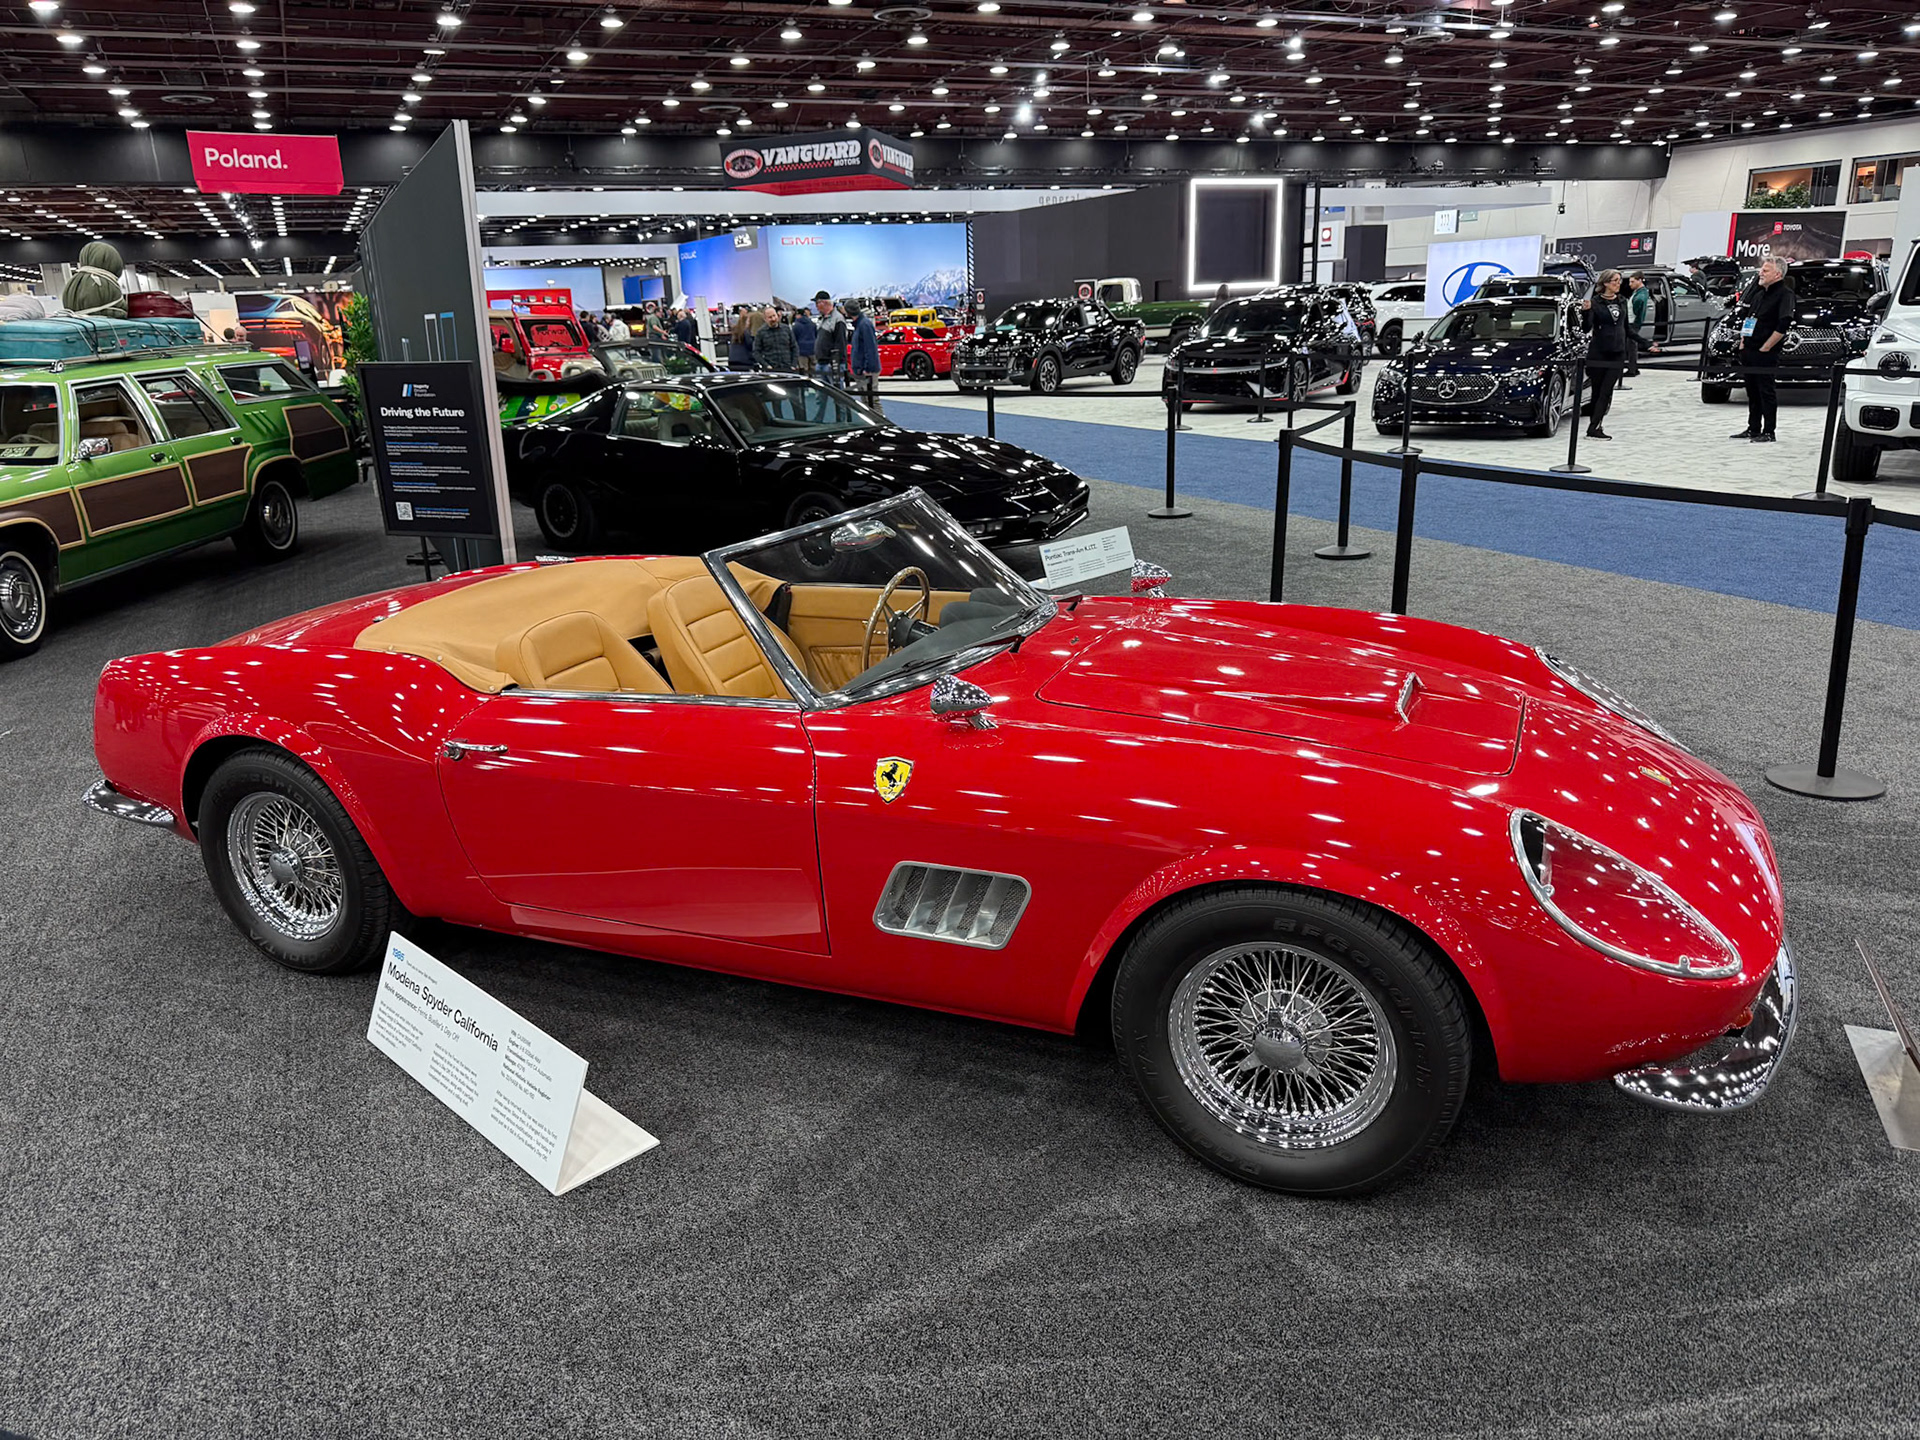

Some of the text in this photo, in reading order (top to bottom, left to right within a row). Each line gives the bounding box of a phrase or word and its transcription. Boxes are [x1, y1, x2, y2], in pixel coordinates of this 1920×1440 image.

[205, 148, 288, 169] Poland.
[761, 140, 861, 166] VANGUARD
[834, 158, 861, 167] MOTORS
[781, 237, 824, 246] GMC
[1560, 242, 1583, 253] LET'S
[1735, 240, 1771, 258] More
[380, 407, 465, 419] Driving the Future
[1045, 552, 1063, 561] Pontiac
[387, 962, 421, 995] Modena
[421, 986, 453, 1018] Spyder
[453, 1009, 499, 1052] California
